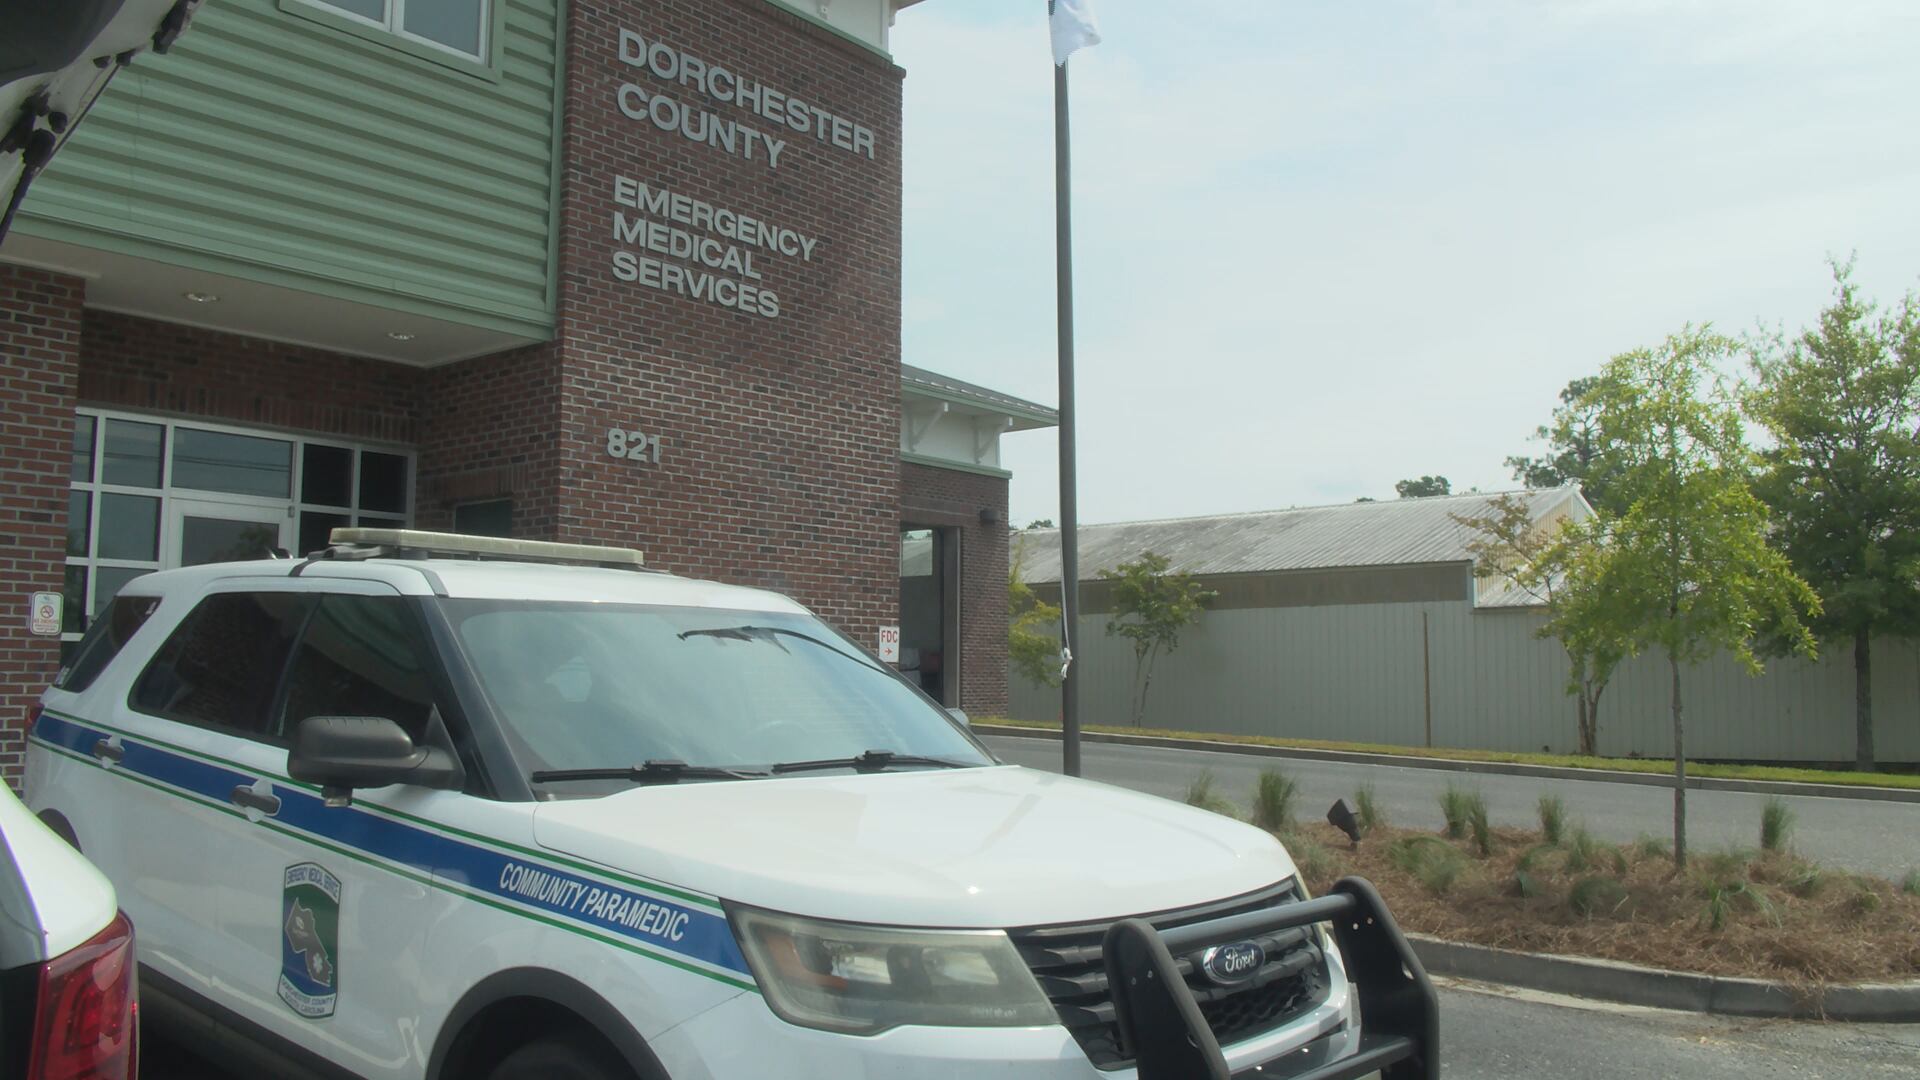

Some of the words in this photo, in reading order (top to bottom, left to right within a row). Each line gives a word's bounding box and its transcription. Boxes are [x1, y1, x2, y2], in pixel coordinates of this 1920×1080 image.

[617, 83, 785, 169] COUNTY
[618, 27, 876, 160] DORCHESTER
[613, 211, 762, 280] MEDICAL
[614, 175, 817, 261] EMERGENCY
[612, 251, 780, 318] SERVICES
[607, 428, 661, 464] 821
[881, 630, 898, 643] FDC
[500, 862, 589, 910] COMMUNITY
[580, 887, 689, 941] PARAMEDIC
[1224, 946, 1257, 973] Ford
